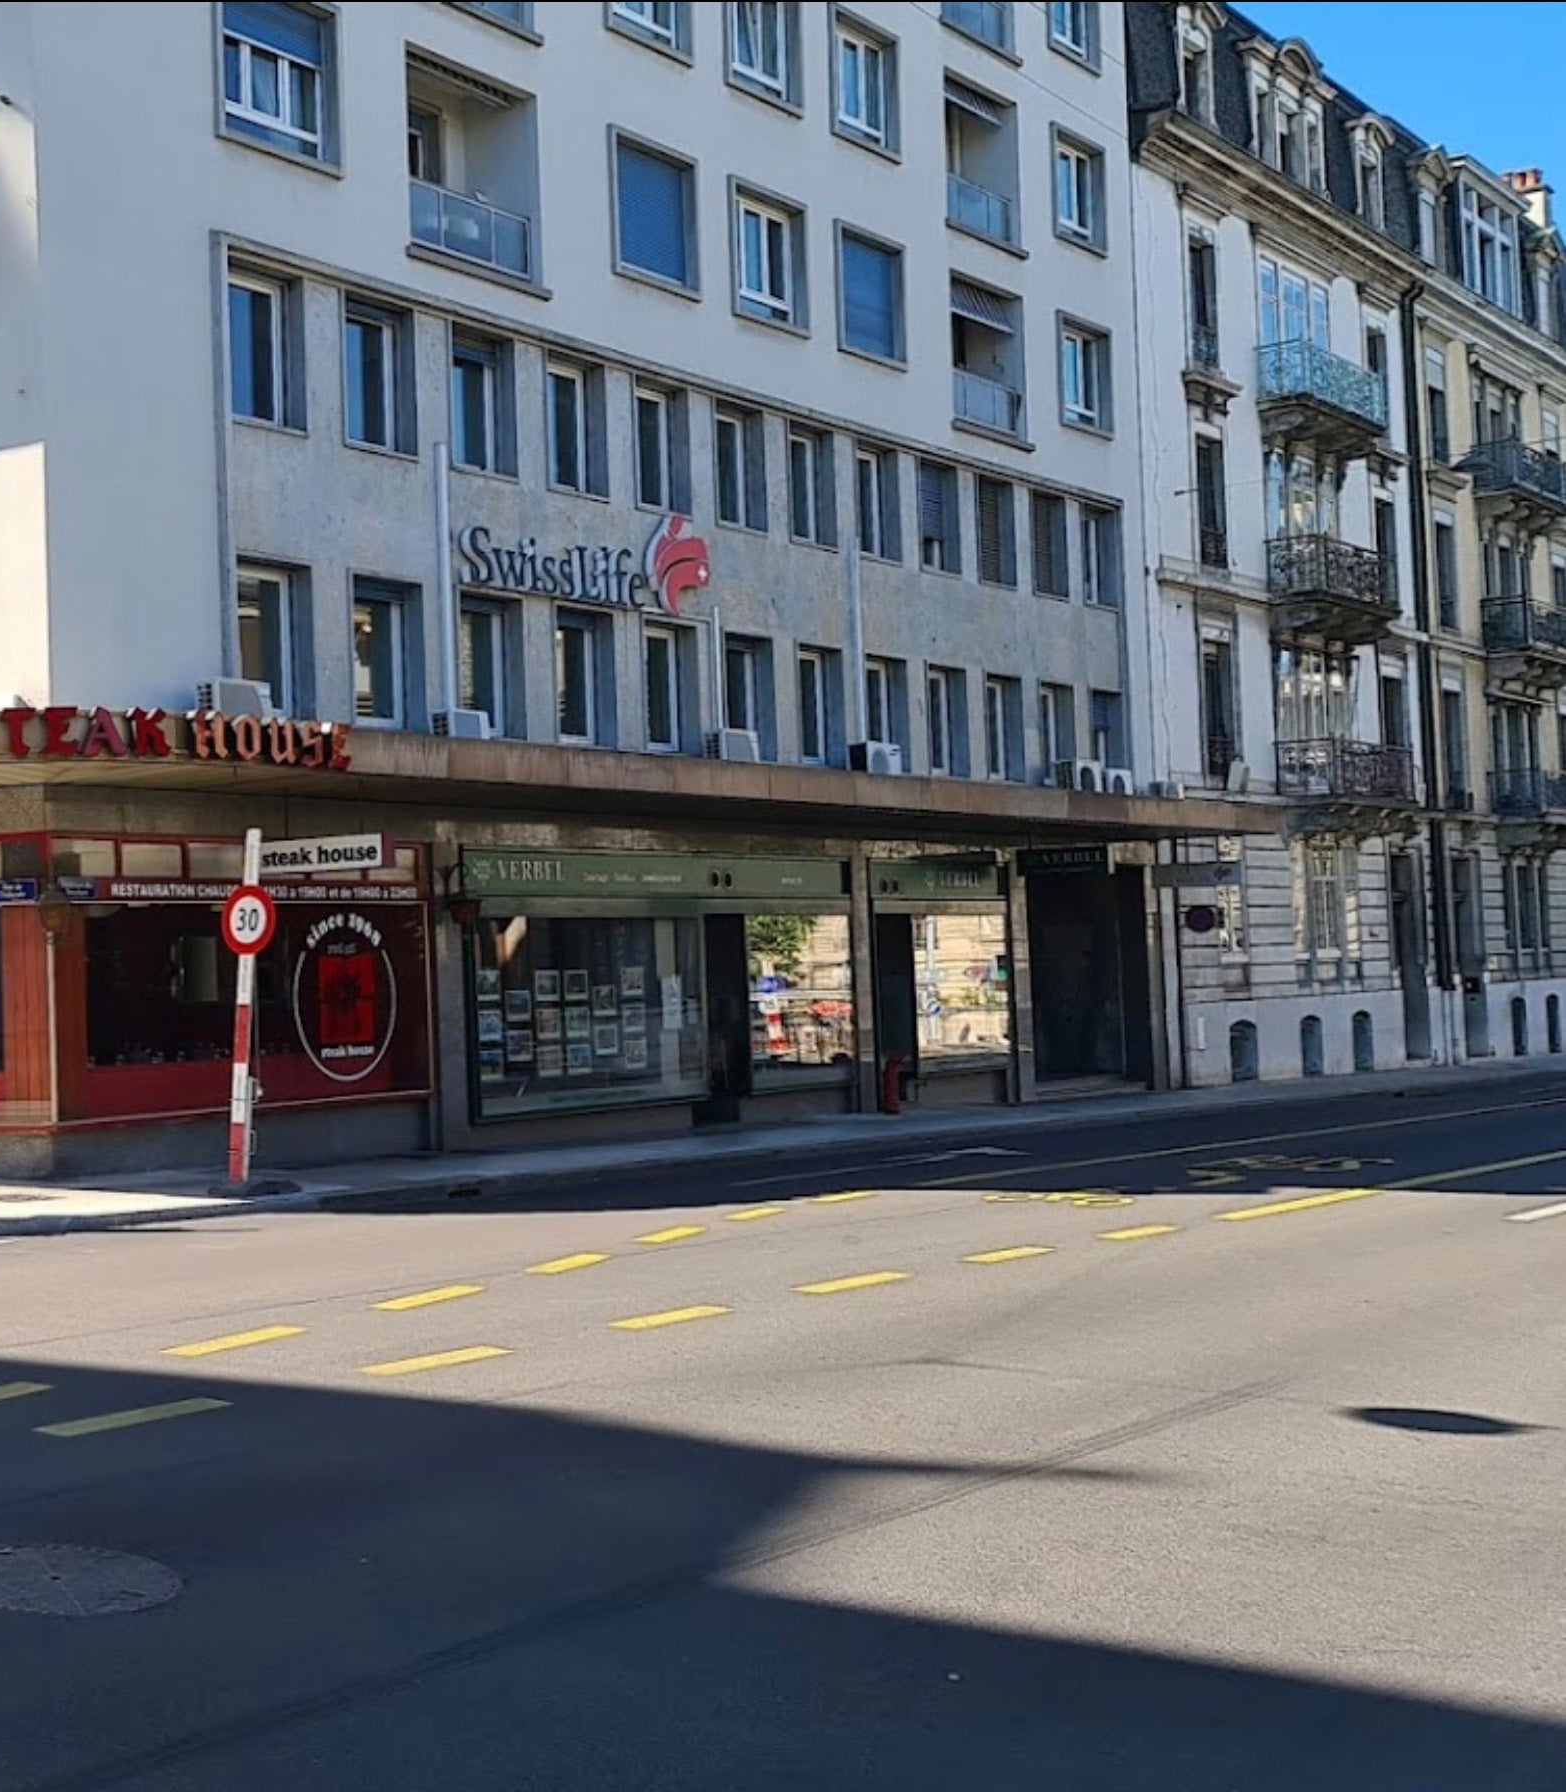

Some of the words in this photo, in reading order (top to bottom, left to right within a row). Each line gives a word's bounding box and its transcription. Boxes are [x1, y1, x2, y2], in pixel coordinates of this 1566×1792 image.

[187, 709, 353, 773] HOUSE
[261, 847, 314, 868] steak
[316, 843, 378, 865] house
[497, 859, 564, 882] VERBEL
[111, 883, 196, 898] RESTAURATION
[236, 907, 260, 932] 30
[306, 913, 345, 949] since
[348, 912, 382, 947] 1968
